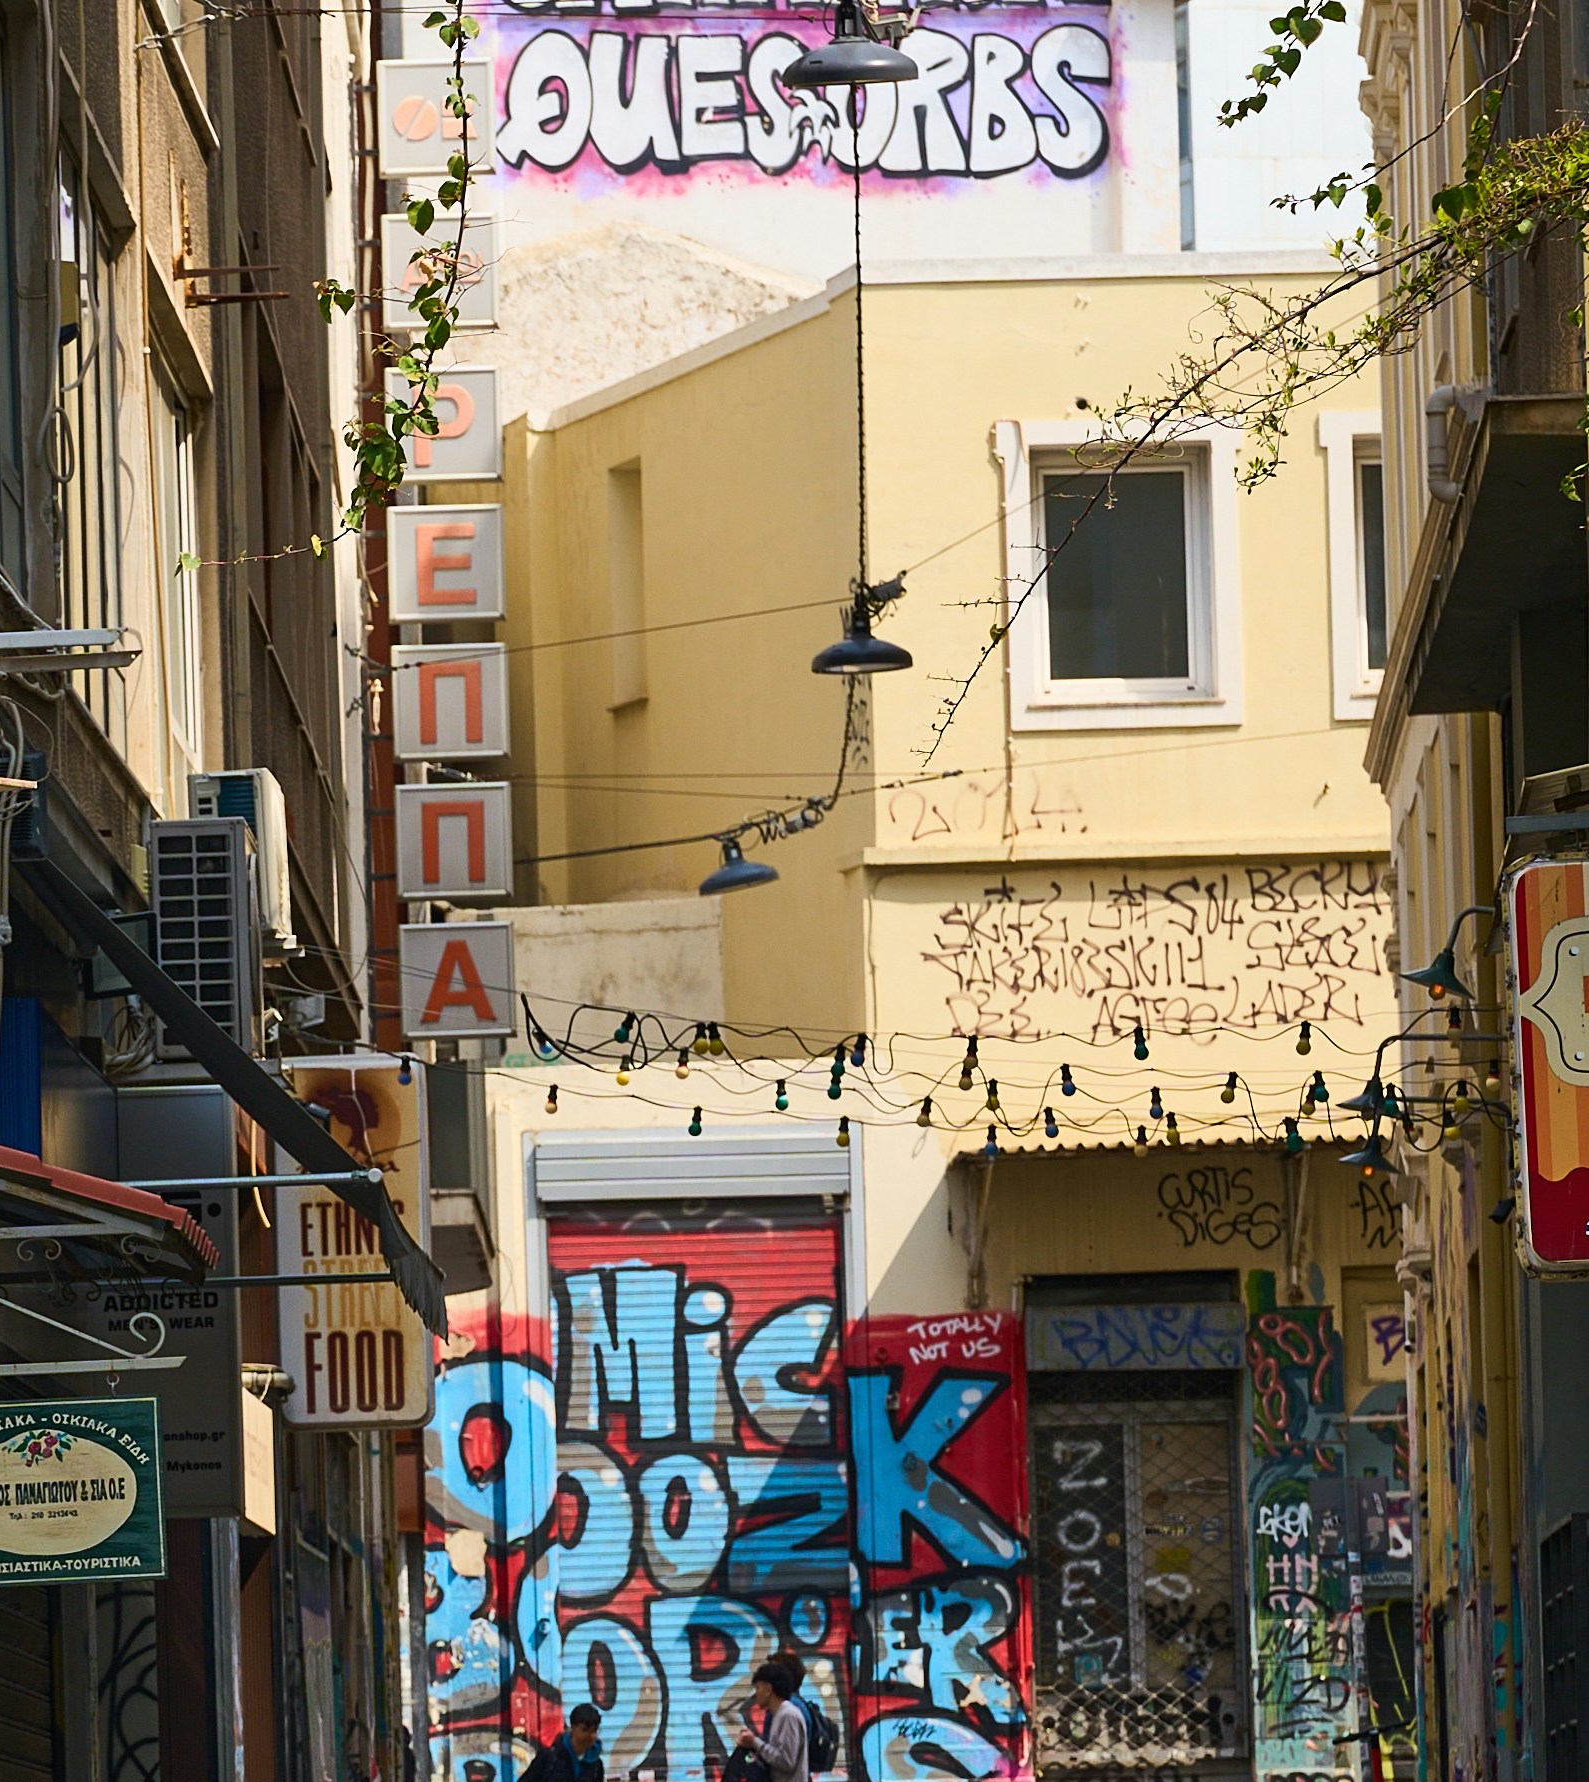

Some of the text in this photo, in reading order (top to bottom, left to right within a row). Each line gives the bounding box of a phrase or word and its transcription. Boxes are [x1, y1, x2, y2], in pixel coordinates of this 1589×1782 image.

[1158, 1165, 1253, 1213] CURTIS
[300, 1202, 405, 1257] ETHN
[103, 1292, 218, 1312] ADDICTED
[169, 1317, 214, 1329] WEAR
[907, 1313, 1001, 1339] TOTALLY
[909, 1337, 1001, 1365] NOT US
[304, 1330, 405, 1414] FOOD
[52, 1413, 116, 1438] ΟΙΚΙΑΚΑ
[118, 1433, 151, 1465] ΕΙΔΗ
[167, 1461, 221, 1474] Mykonos
[90, 1478, 107, 1502] ΣΙΑ
